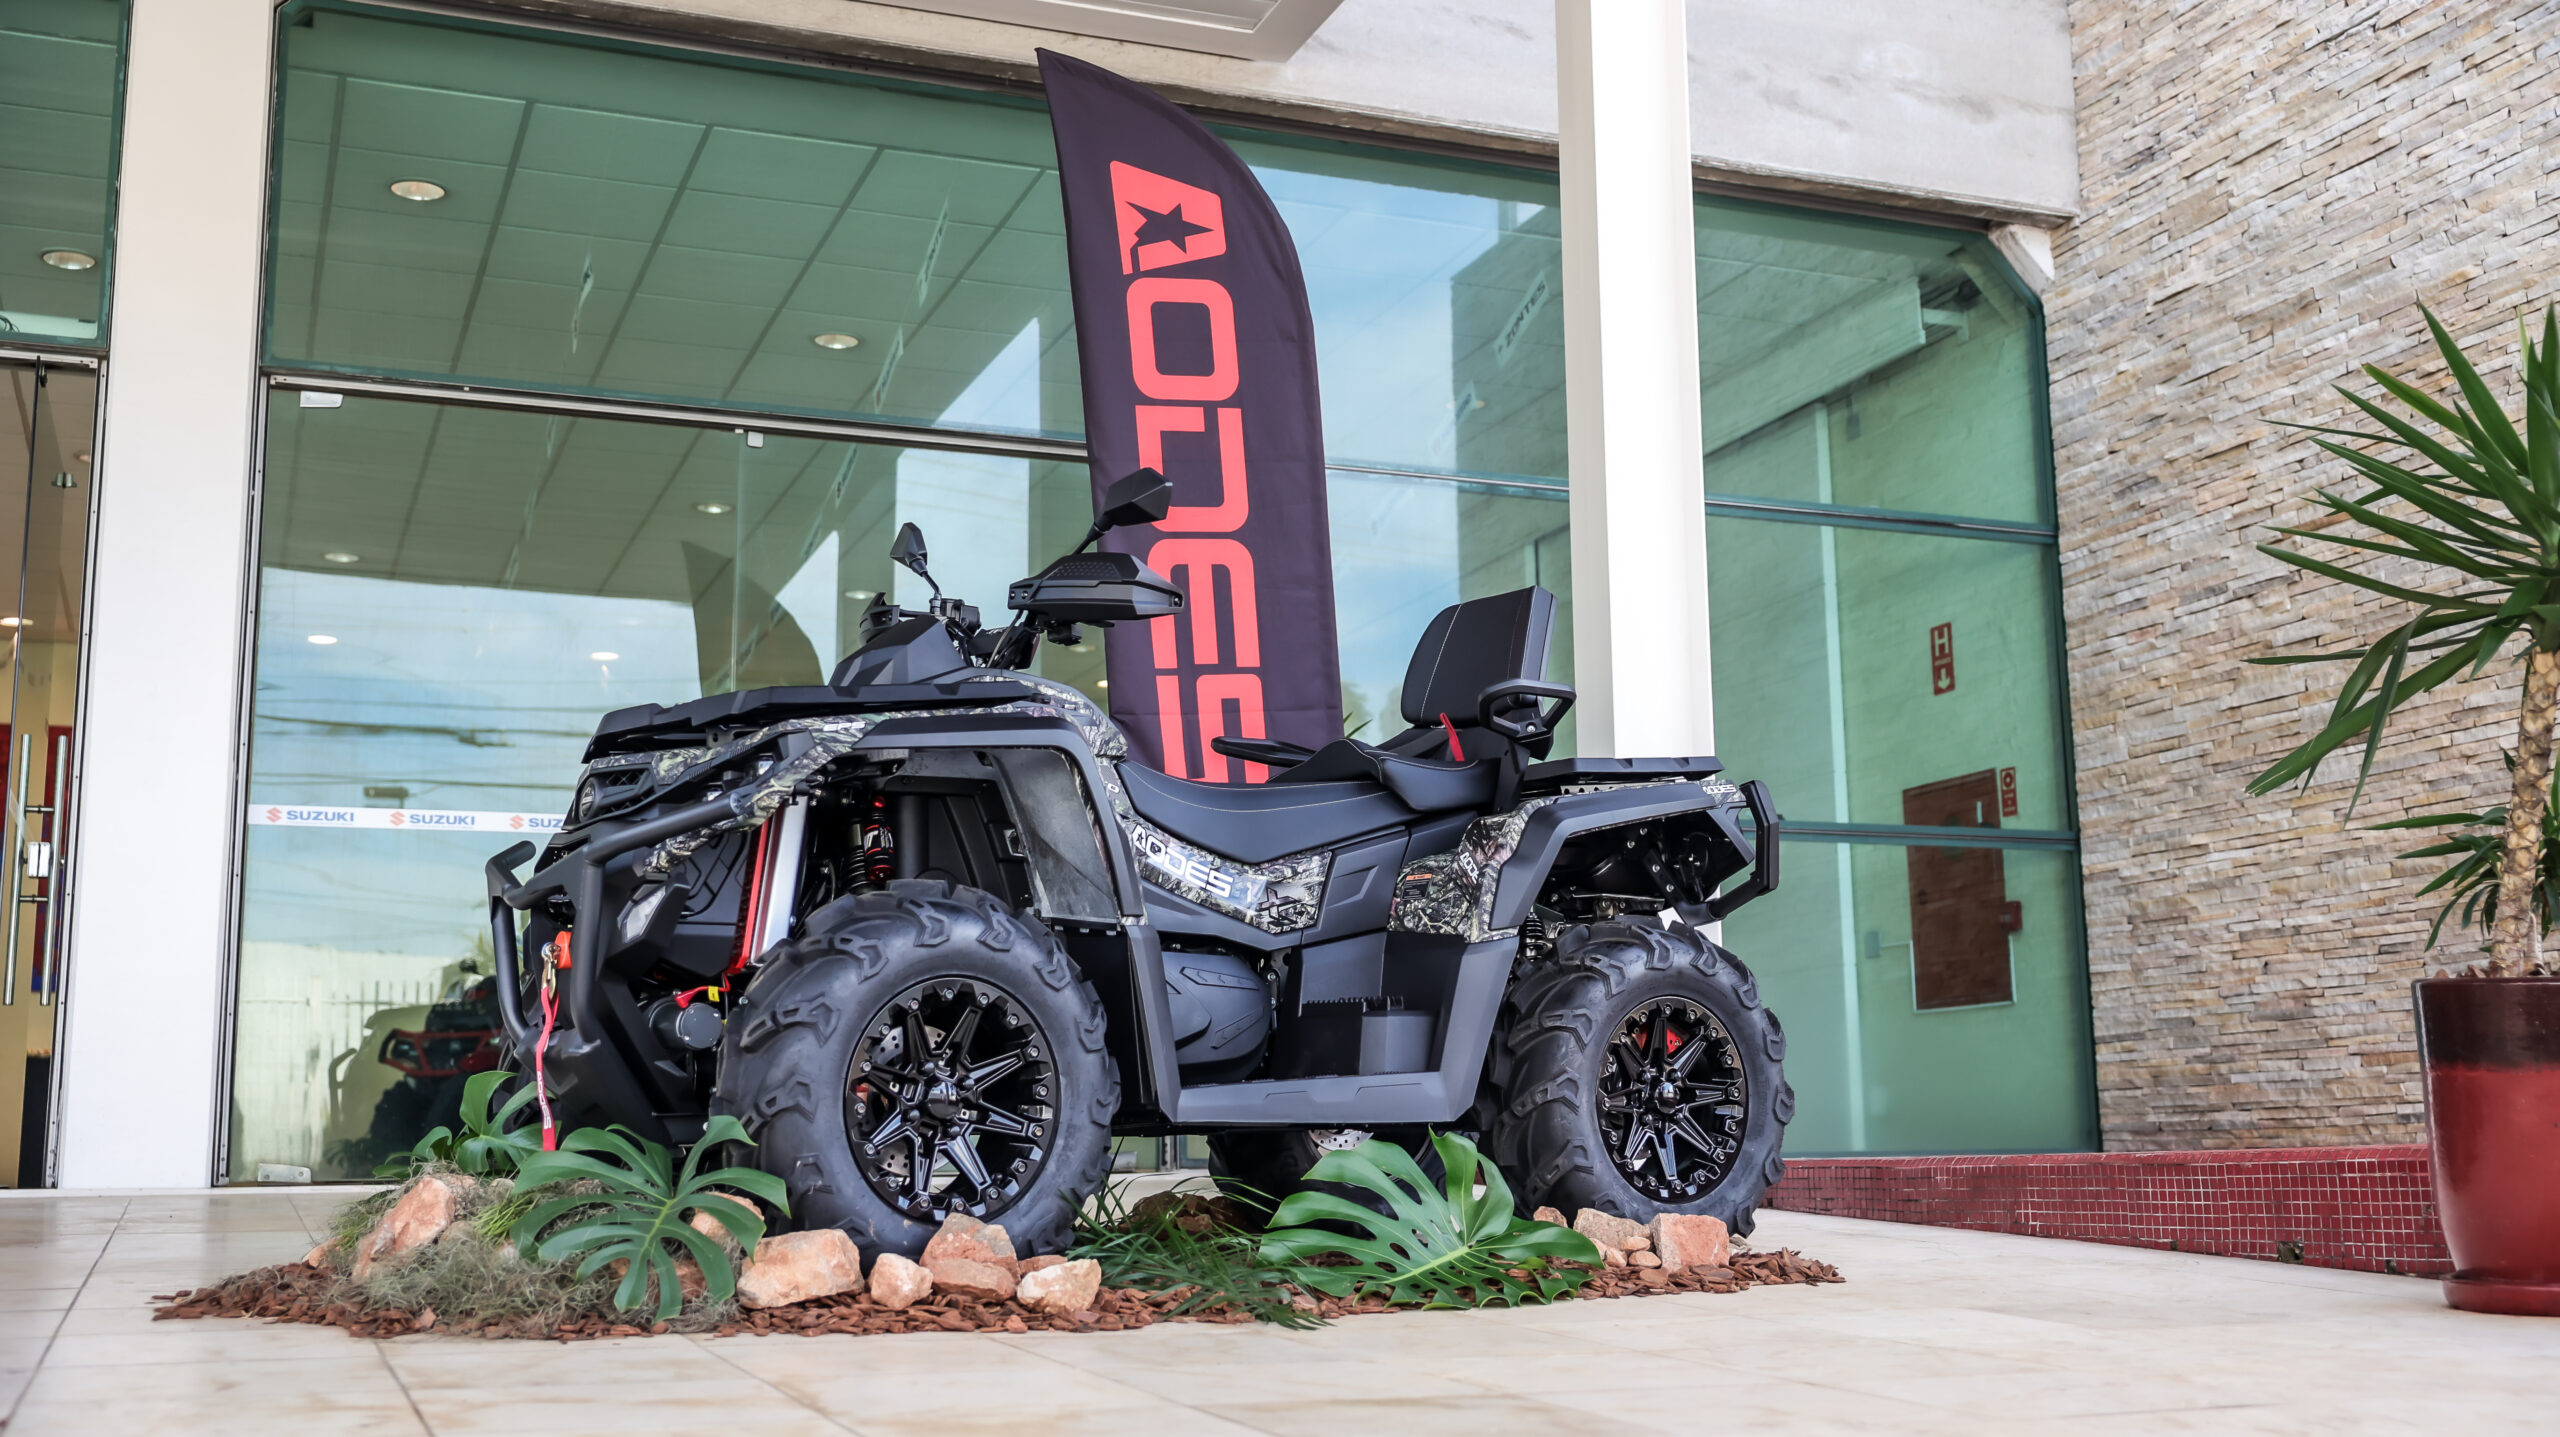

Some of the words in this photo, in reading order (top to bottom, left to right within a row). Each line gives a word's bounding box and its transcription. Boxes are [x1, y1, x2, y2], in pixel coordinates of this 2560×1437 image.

[1934, 626, 1949, 657] H
[286, 810, 354, 822] SUZUKI
[409, 814, 476, 826] SUZUKI
[528, 817, 563, 829] SUZ
[1132, 825, 1234, 898] AODES
[1459, 851, 1480, 885] AODE
